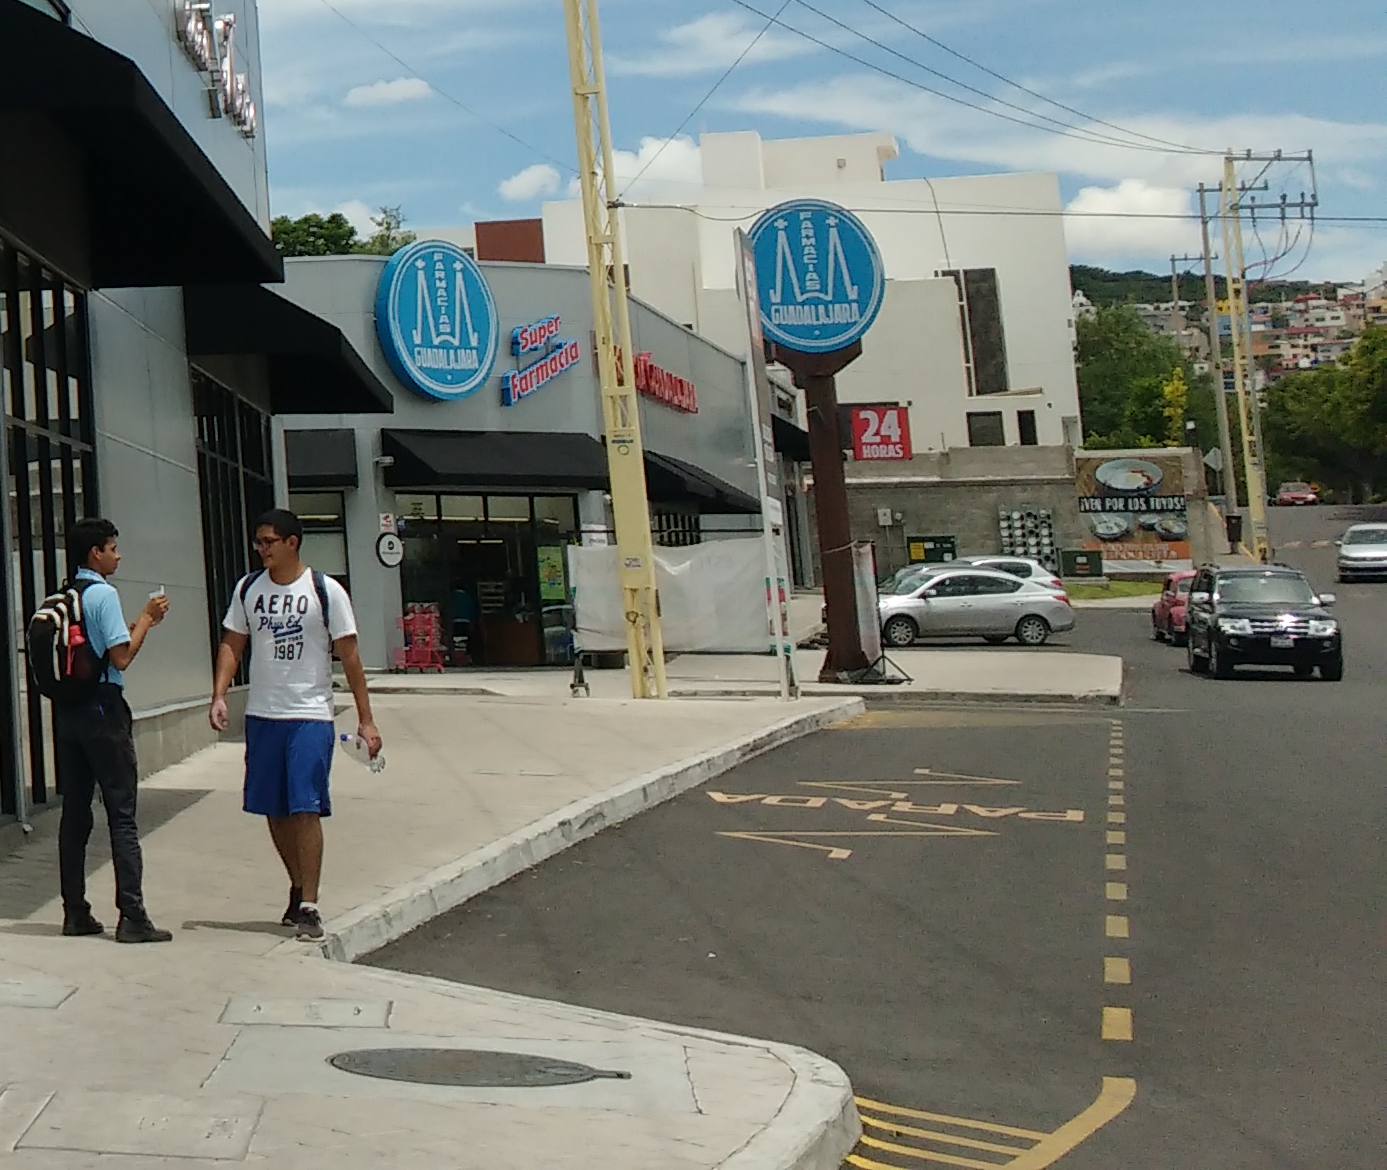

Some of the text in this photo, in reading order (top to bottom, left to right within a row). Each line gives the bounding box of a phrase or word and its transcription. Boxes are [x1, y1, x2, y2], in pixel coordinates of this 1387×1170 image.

[799, 211, 821, 290] FARMACIAS
[433, 253, 452, 333] FARMACIAS
[770, 302, 861, 326] GUADALAJARA
[520, 315, 561, 352] Super
[414, 347, 479, 371] GUADALAJARA
[510, 340, 580, 401] Farmacia
[859, 410, 902, 443] 24
[862, 444, 904, 459] HORAS
[1105, 498, 1125, 511] POR
[1128, 498, 1147, 511] LOS
[254, 594, 309, 615] AERO
[257, 616, 285, 633] Phys
[274, 641, 304, 661] 1987
[706, 790, 1085, 822] PARADA
